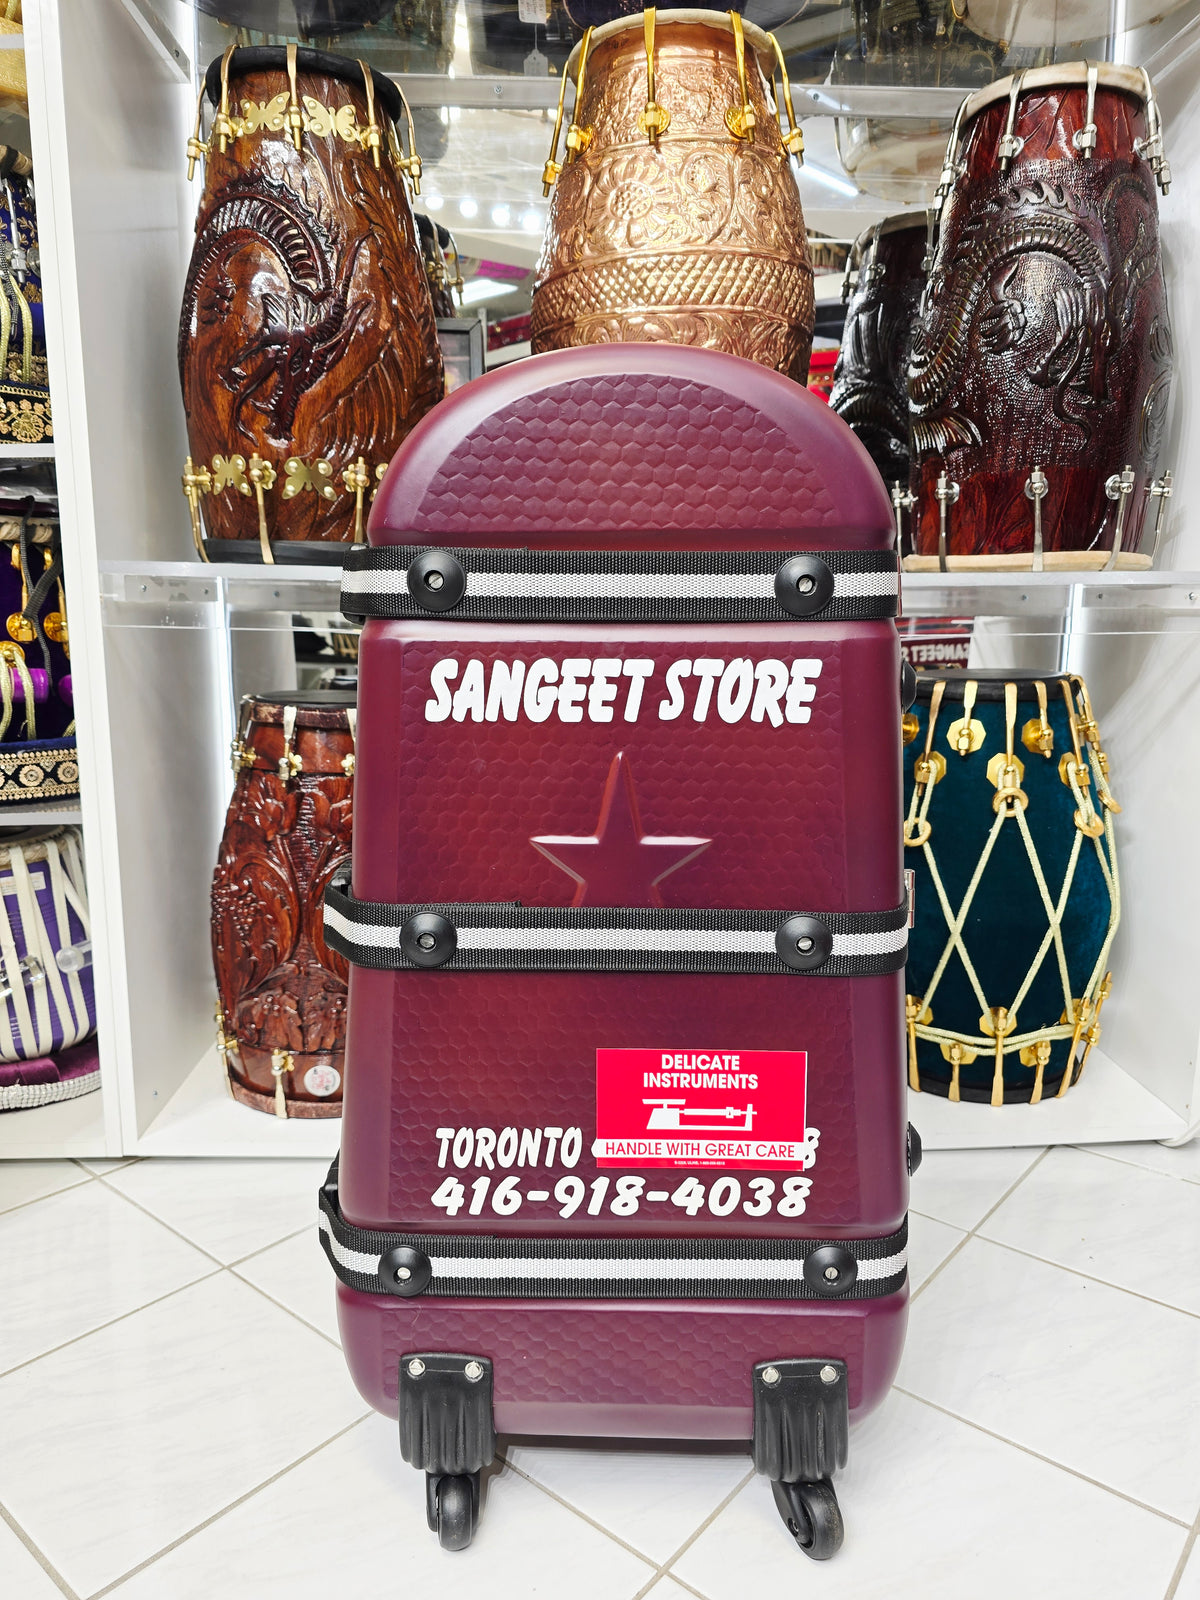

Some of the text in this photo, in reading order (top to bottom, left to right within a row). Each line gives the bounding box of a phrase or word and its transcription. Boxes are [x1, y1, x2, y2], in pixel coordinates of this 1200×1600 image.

[424, 657, 823, 728] SANGEET STORE
[661, 1054, 740, 1071] DELICATE
[643, 1072, 759, 1090] INSTRUMENTS
[435, 1126, 583, 1170] TORONTO
[605, 1141, 795, 1158] HANDLE WITH GREAT CARE
[430, 1175, 814, 1219] 416-918-4038
